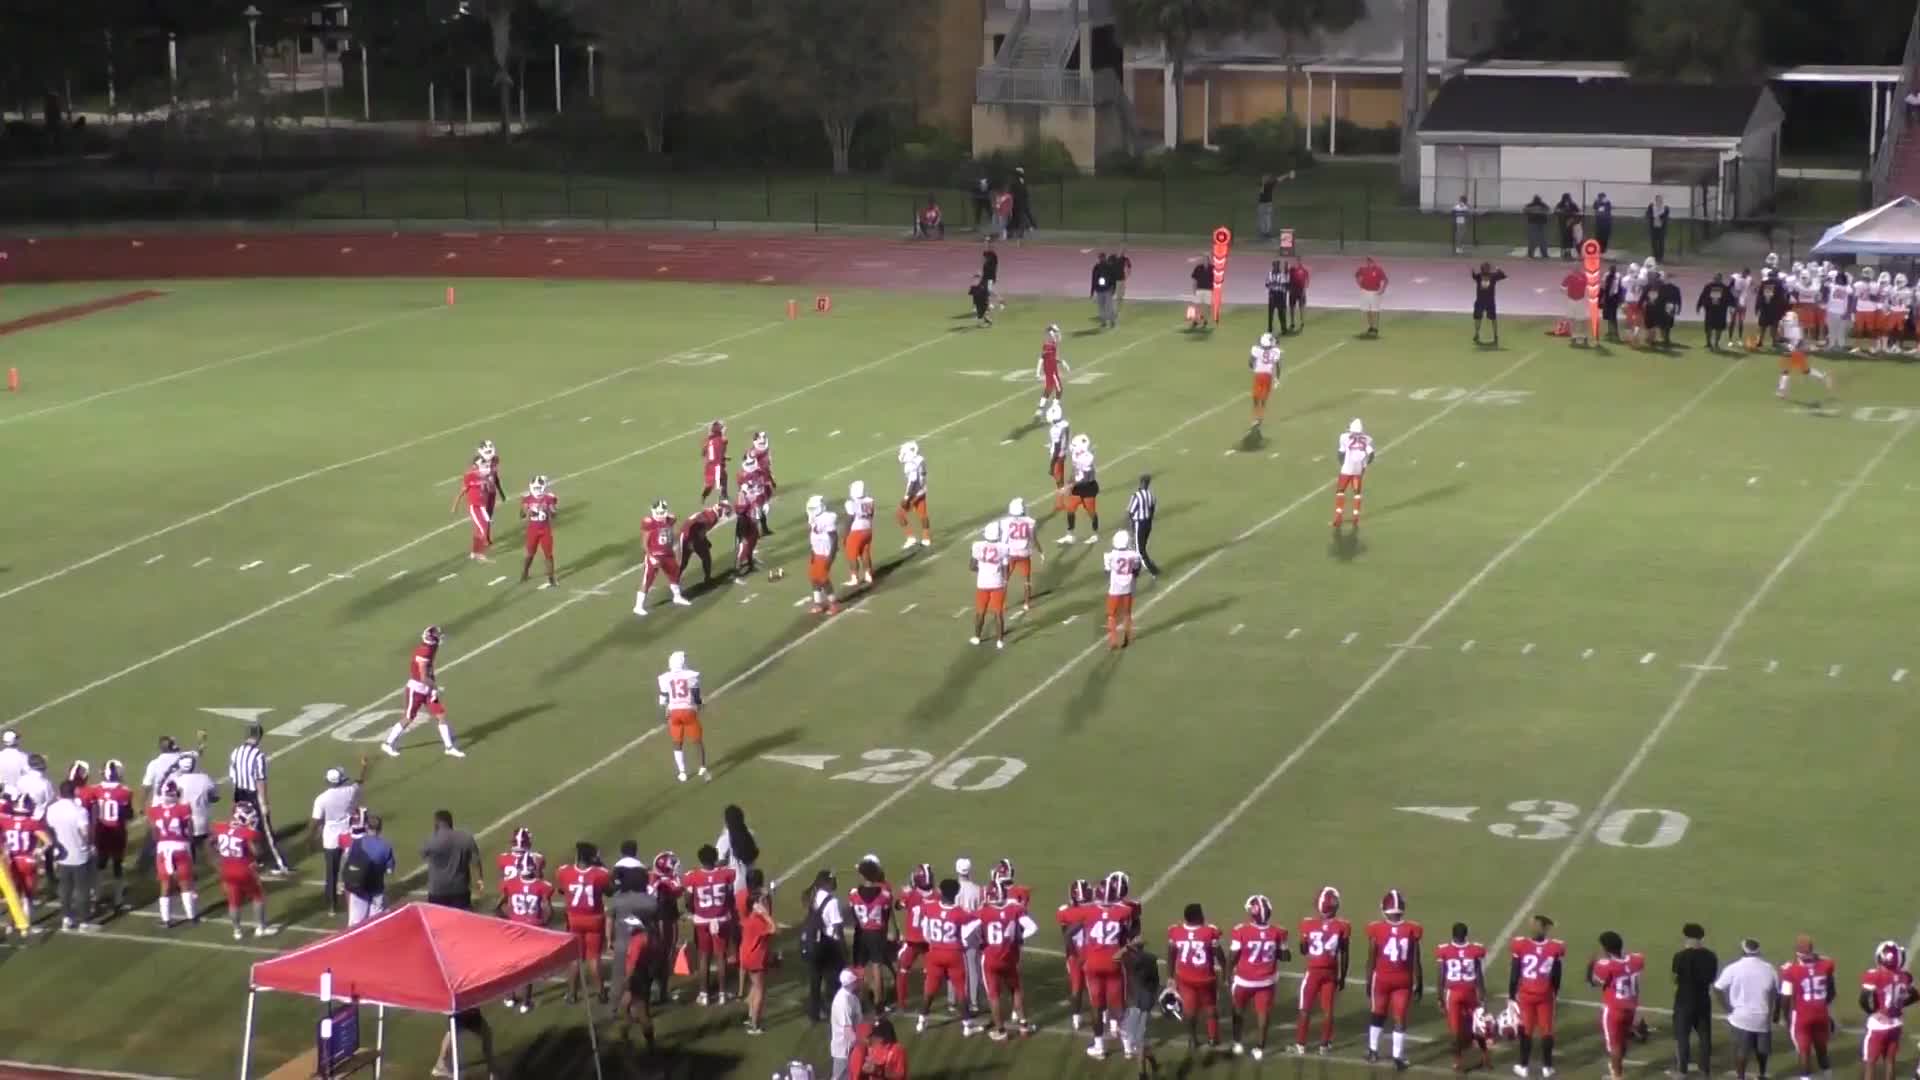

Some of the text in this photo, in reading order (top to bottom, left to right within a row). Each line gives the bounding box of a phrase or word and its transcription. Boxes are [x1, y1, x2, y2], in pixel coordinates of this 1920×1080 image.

[1349, 436, 1367, 450] 25
[1009, 522, 1030, 540] 20
[981, 546, 999, 564] 12
[670, 679, 689, 699] 13
[266, 703, 433, 743] 10
[829, 748, 1028, 791] 20
[1487, 799, 1692, 849] 30
[218, 833, 244, 859] 25
[568, 883, 595, 907] 71
[696, 883, 728, 909] 55
[987, 920, 1015, 945] 64
[1089, 920, 1120, 945] 42
[1309, 931, 1341, 956] 34
[1176, 940, 1208, 966] 73
[1383, 936, 1408, 962] 41
[1520, 954, 1555, 980] 24
[1801, 975, 1828, 1002] 15
